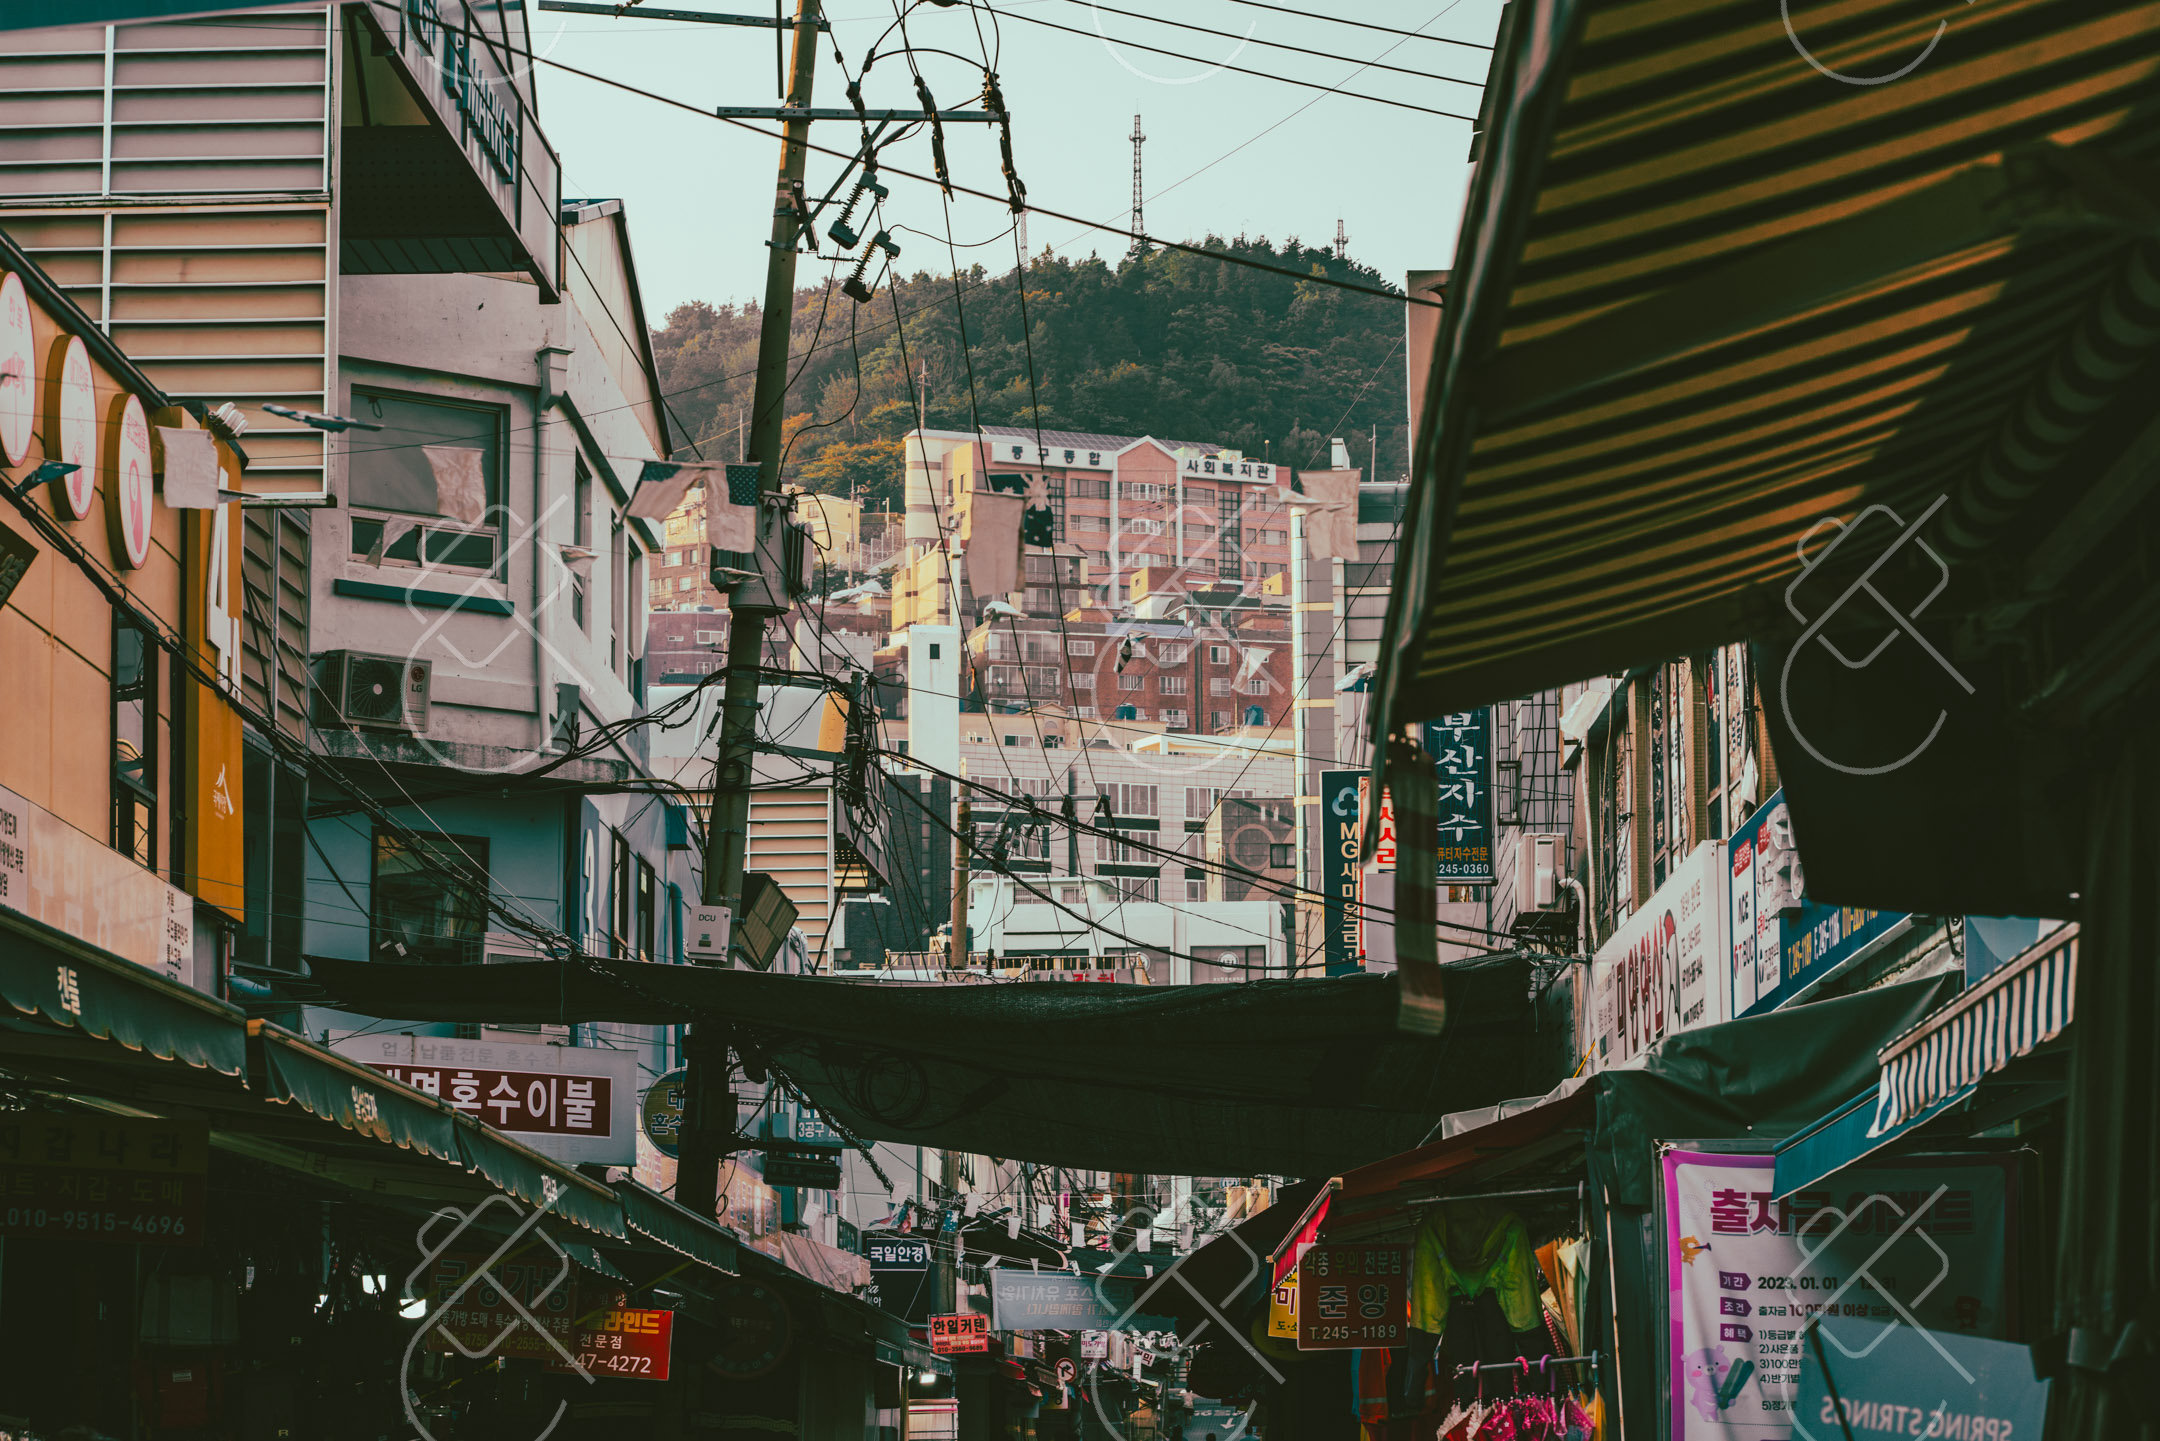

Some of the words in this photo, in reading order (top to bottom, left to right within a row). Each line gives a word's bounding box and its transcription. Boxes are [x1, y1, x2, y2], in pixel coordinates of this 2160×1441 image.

[1186, 458, 1271, 480] 사회복지관
[411, 685, 423, 693] LG
[1431, 712, 1485, 843] 부산자수
[698, 914, 716, 922] DCU
[798, 1122, 825, 1138] 3공구
[1709, 1189, 1832, 1236] 출자금
[870, 1246, 924, 1263] 국일안경
[1364, 1251, 1401, 1276] 전문점
[1722, 1274, 1743, 1288] 기간
[1724, 1300, 1745, 1313] 조건
[1758, 1306, 1787, 1317] 출자금
[1309, 1325, 1397, 1340] T.245-1189
[1723, 1327, 1747, 1340] 혜택
[580, 1333, 622, 1350] 전문점
